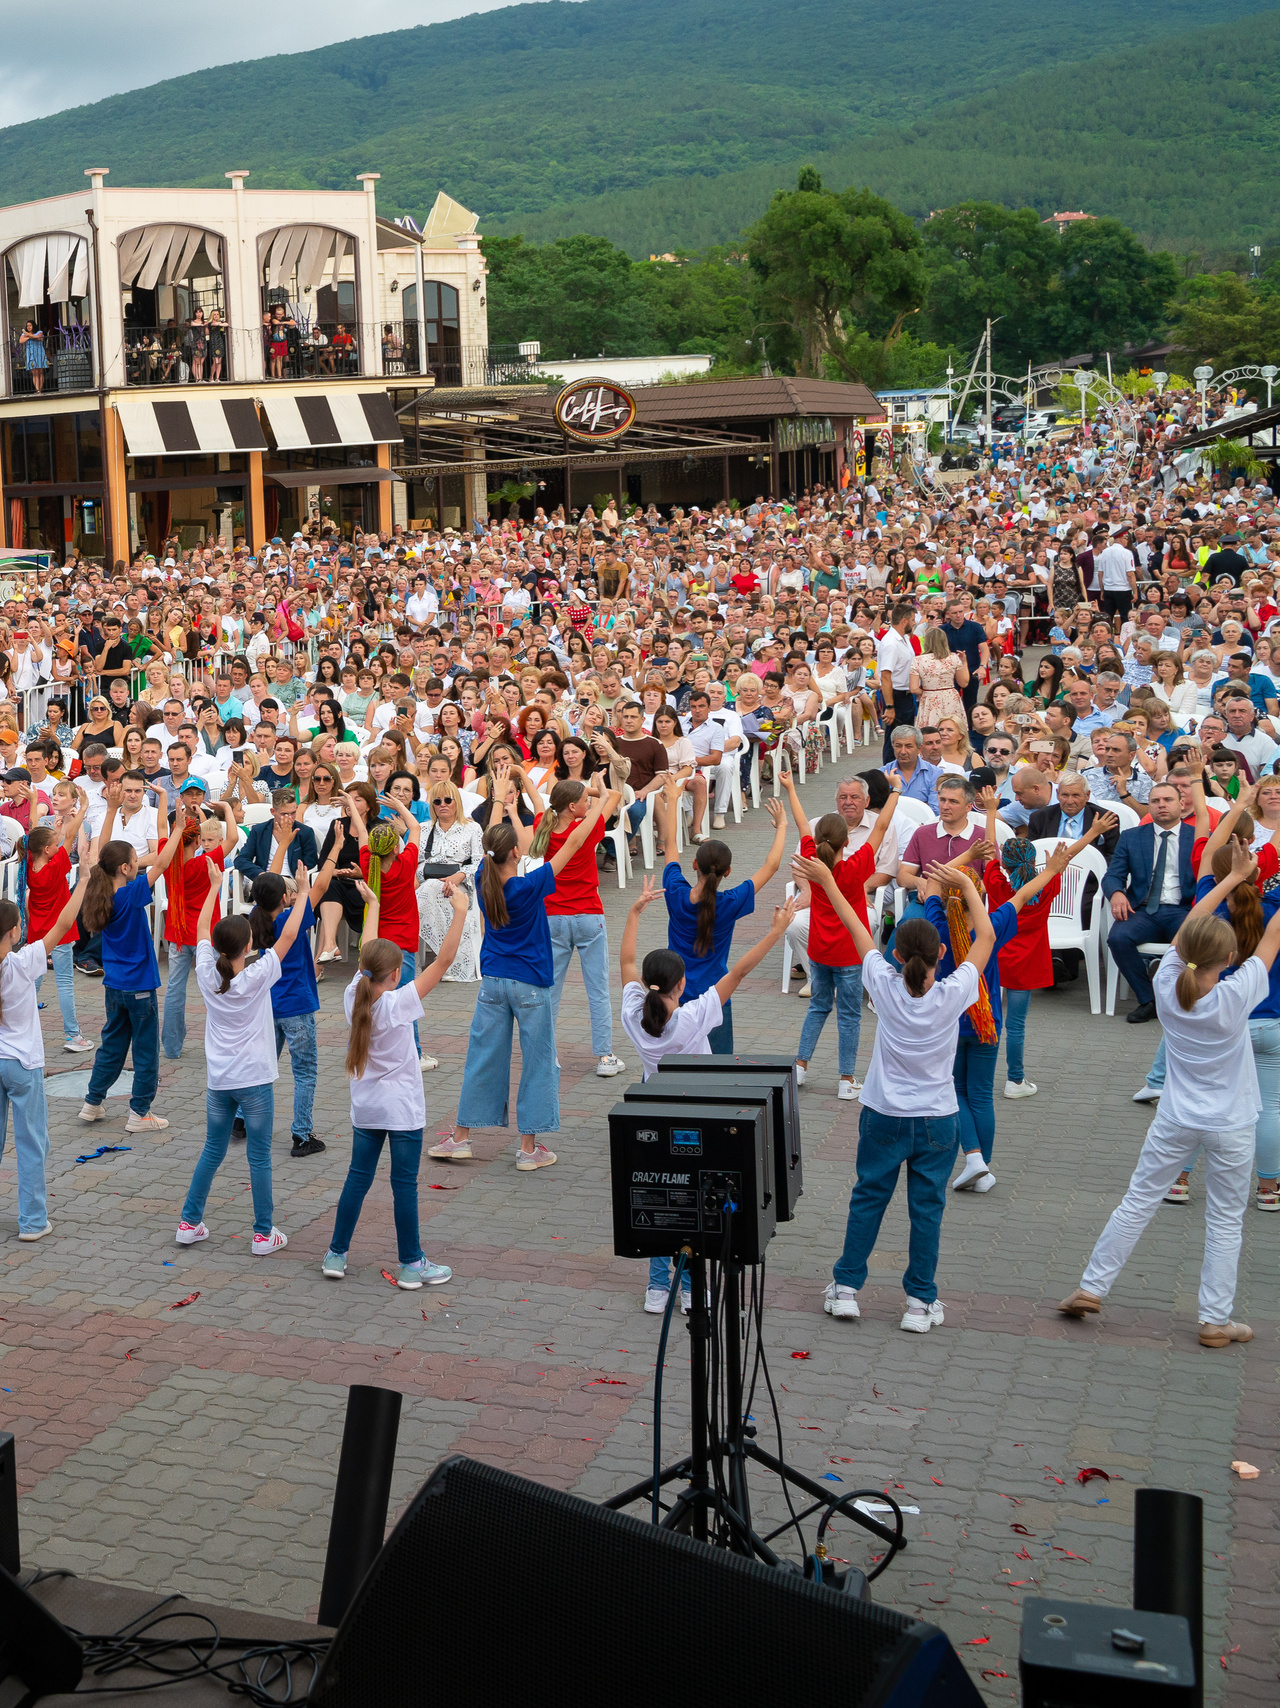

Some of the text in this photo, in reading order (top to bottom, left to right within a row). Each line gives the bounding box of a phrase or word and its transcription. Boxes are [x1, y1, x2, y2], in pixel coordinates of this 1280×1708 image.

[638, 1131, 657, 1141] MFX
[632, 1171, 691, 1185] CRAZY FLAME
